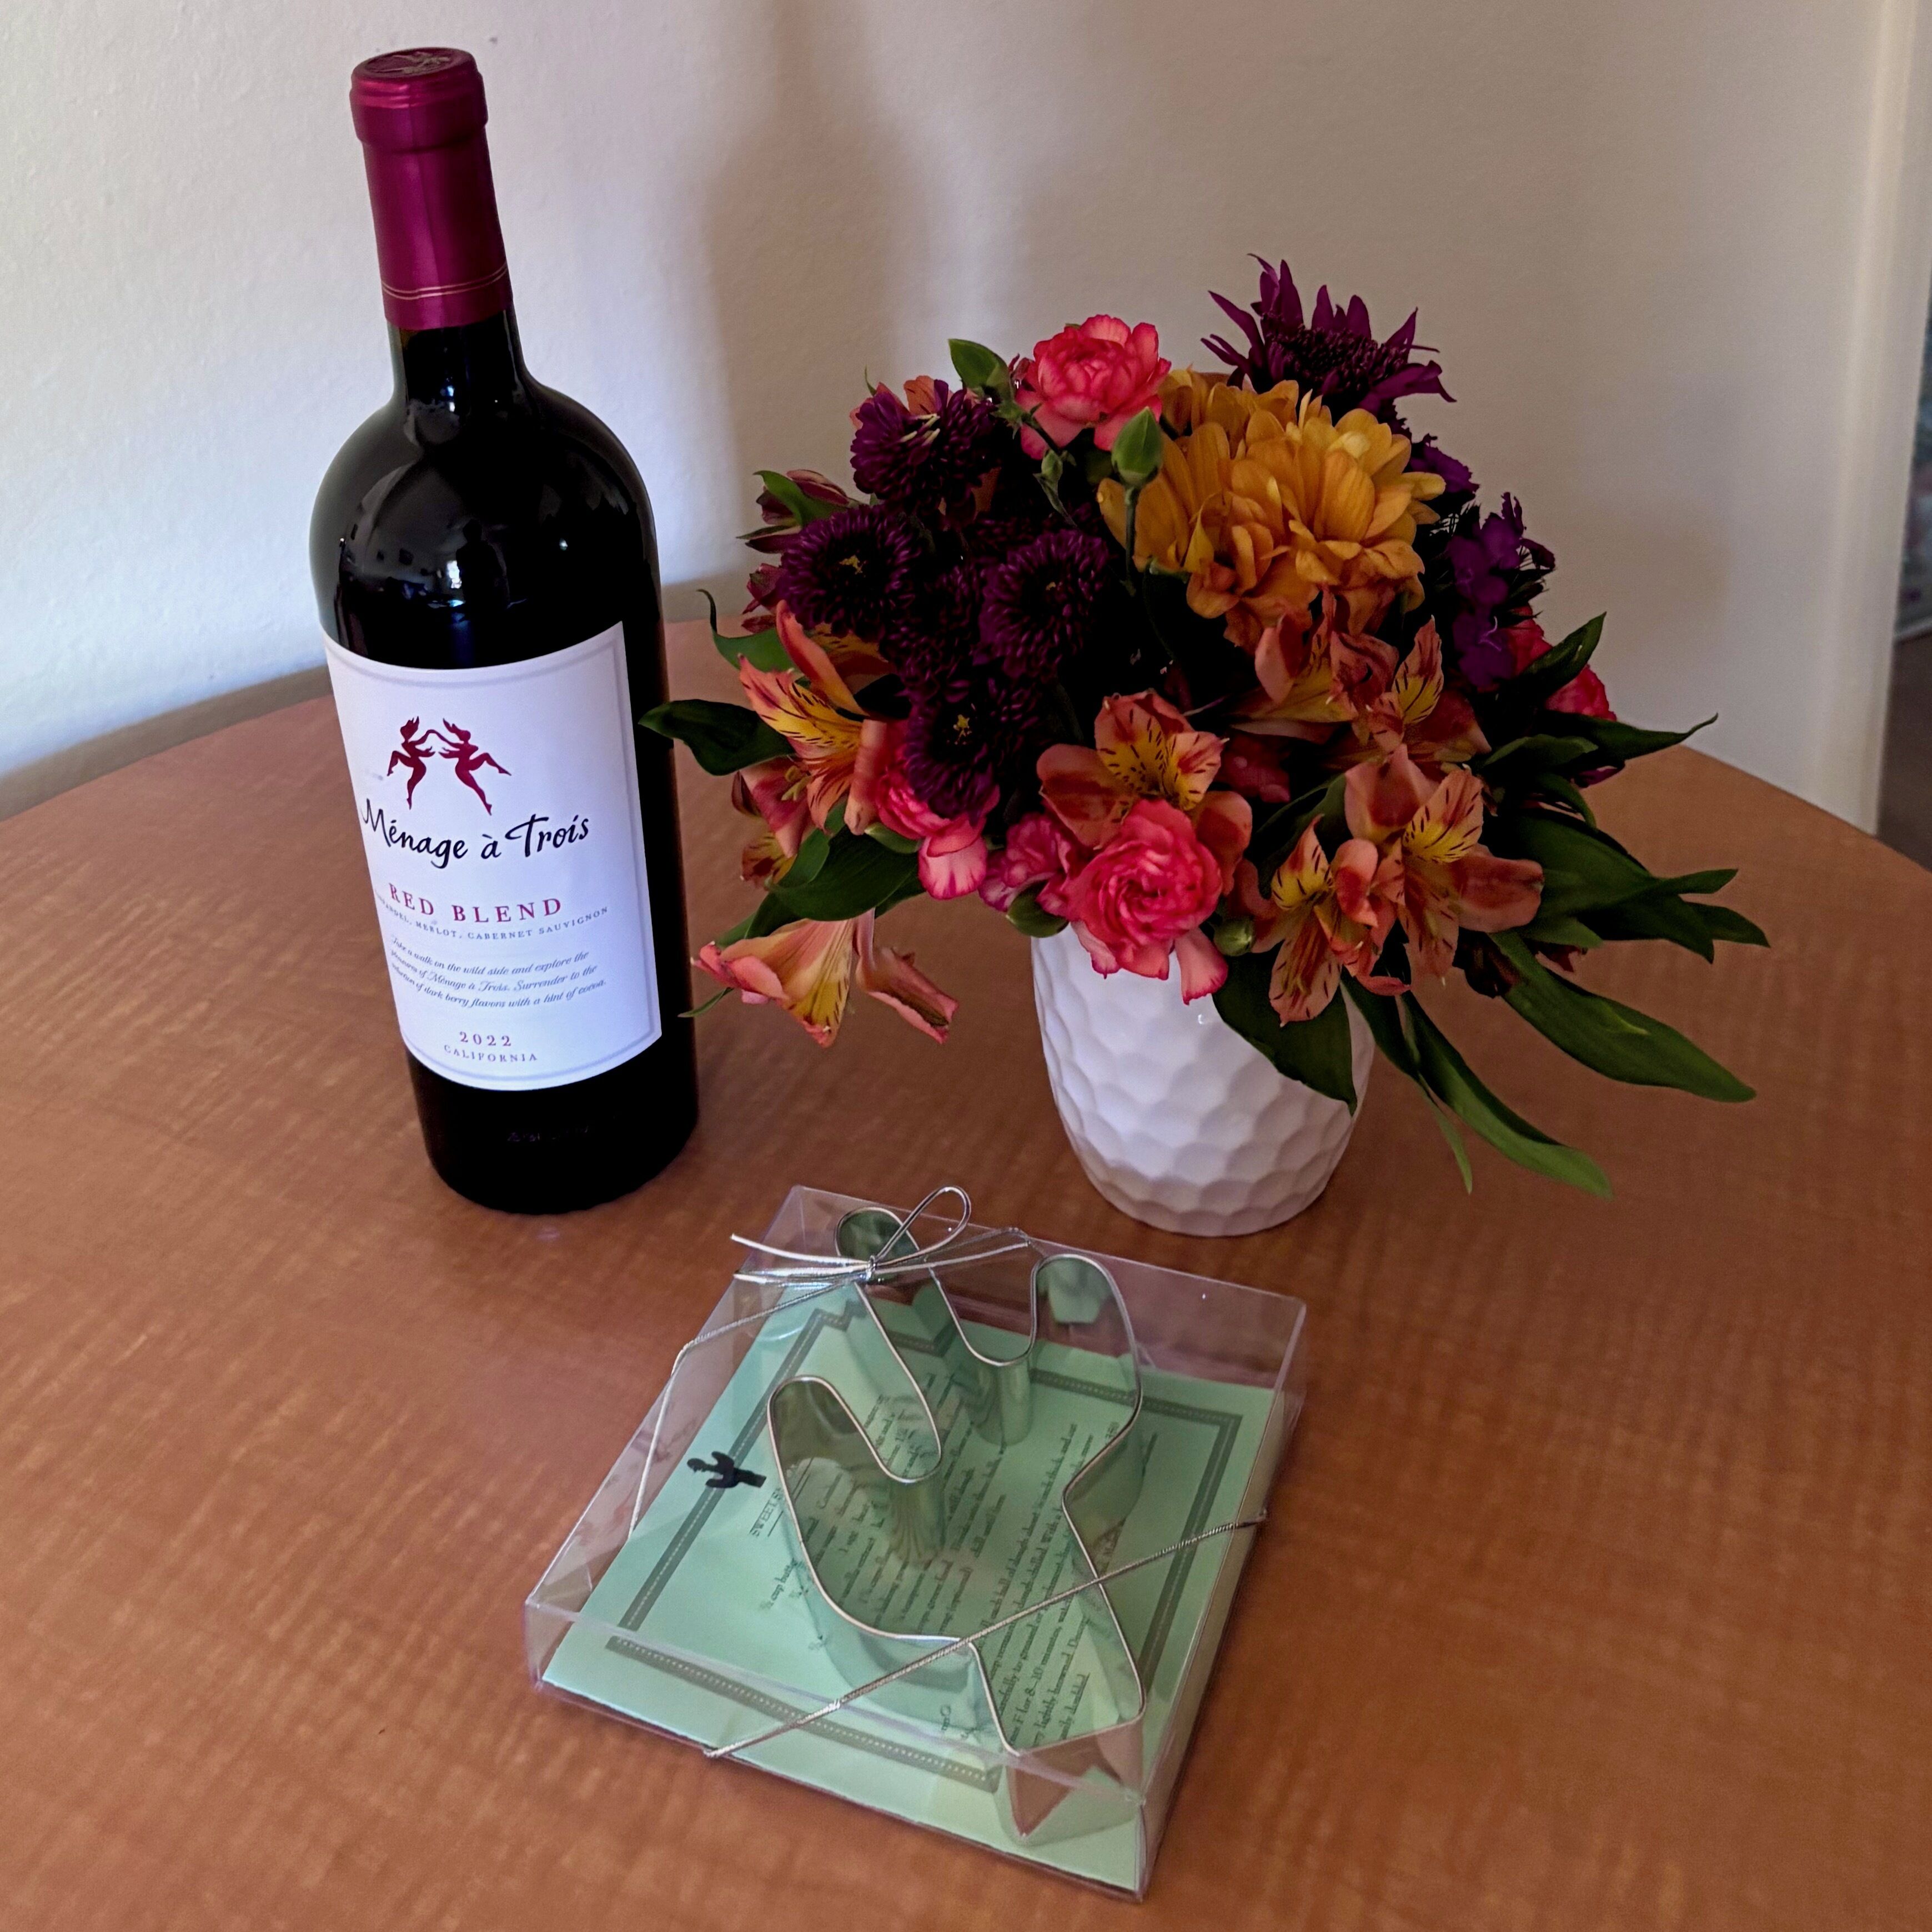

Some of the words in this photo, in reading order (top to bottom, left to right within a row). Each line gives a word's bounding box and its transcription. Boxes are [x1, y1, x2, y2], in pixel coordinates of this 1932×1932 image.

[362, 798, 468, 869] Ménage
[480, 834, 502, 859] à
[505, 814, 589, 857] Trois
[389, 882, 434, 915] RED
[451, 898, 561, 923] BLEND
[416, 921, 462, 939] MERLOT,
[468, 930, 533, 940] CABERNET
[539, 906, 608, 935] SAUVIGNON
[414, 953, 433, 966] walk
[447, 964, 461, 972] the
[464, 966, 486, 975] wild
[488, 966, 509, 975] side
[511, 964, 534, 975] and
[535, 959, 571, 972] explore
[574, 951, 589, 962] the
[514, 976, 568, 991] Surrender
[570, 971, 580, 980] to
[583, 965, 598, 976] the
[424, 986, 444, 999] dark
[445, 993, 469, 1007] berry
[468, 998, 506, 1008] flavors
[509, 997, 531, 1007] with
[544, 992, 564, 1003] hint
[566, 987, 579, 1001] of
[459, 1031, 511, 1046] 2022
[444, 1045, 538, 1062] CALIFORNIA
[747, 1499, 778, 1538] SWEET
